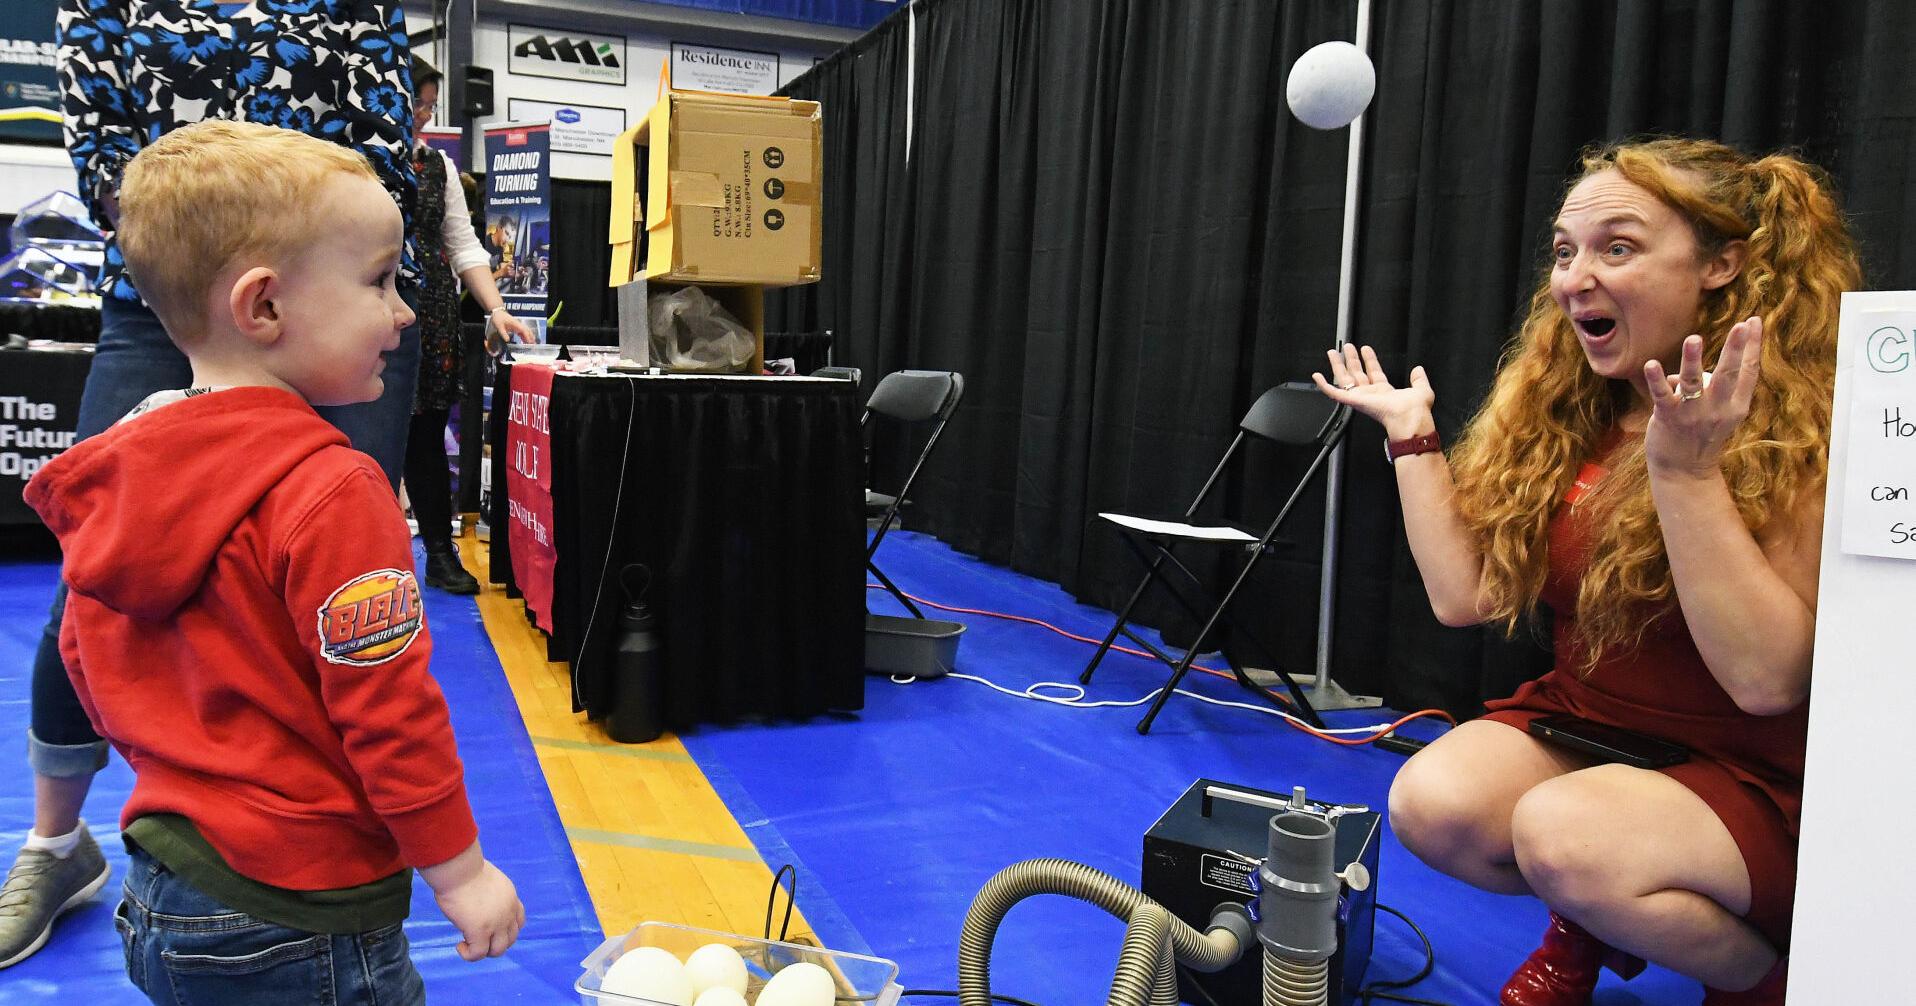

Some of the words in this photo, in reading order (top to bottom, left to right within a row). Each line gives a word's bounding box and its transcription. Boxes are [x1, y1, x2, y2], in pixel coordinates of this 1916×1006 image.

[681, 49, 752, 70] Residence
[754, 61, 770, 71] INN
[579, 66, 621, 79] GRAPHICS
[493, 151, 540, 172] DIAMOND
[494, 173, 539, 193] TURNING
[0, 396, 56, 420] The
[0, 424, 77, 449] Futur
[1871, 486, 1908, 501] can
[329, 576, 420, 646] BLAZE
